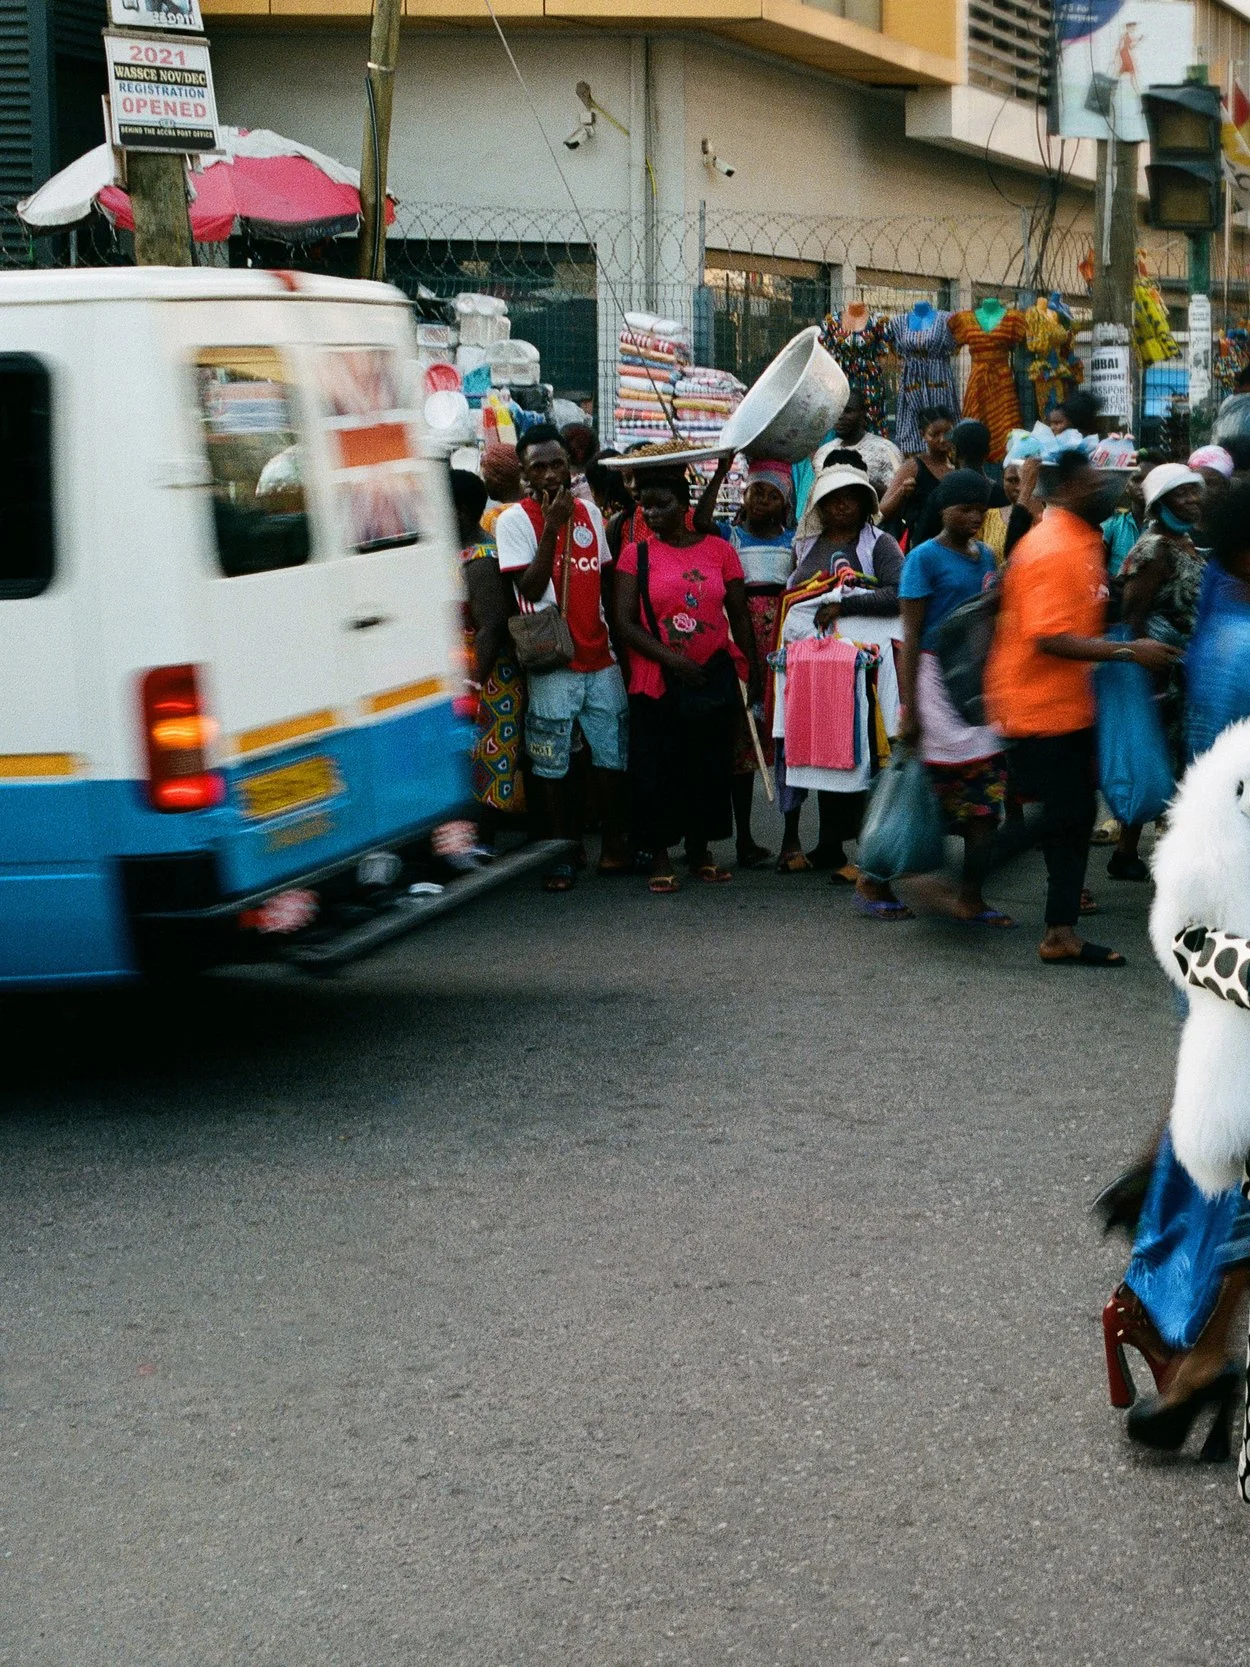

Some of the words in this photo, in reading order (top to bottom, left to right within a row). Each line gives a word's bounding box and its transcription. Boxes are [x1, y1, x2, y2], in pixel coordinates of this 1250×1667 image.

[129, 45, 186, 66] 2021
[115, 65, 158, 81] WASSCE
[160, 70, 206, 85] NOV/DEC
[119, 82, 206, 98] REGISTRATION
[122, 97, 207, 118] OPENED
[120, 125, 143, 135] BEHIND
[144, 127, 157, 136] THE
[157, 128, 176, 137] ACCRA
[176, 129, 192, 138] POST
[193, 130, 213, 139] OFFICE
